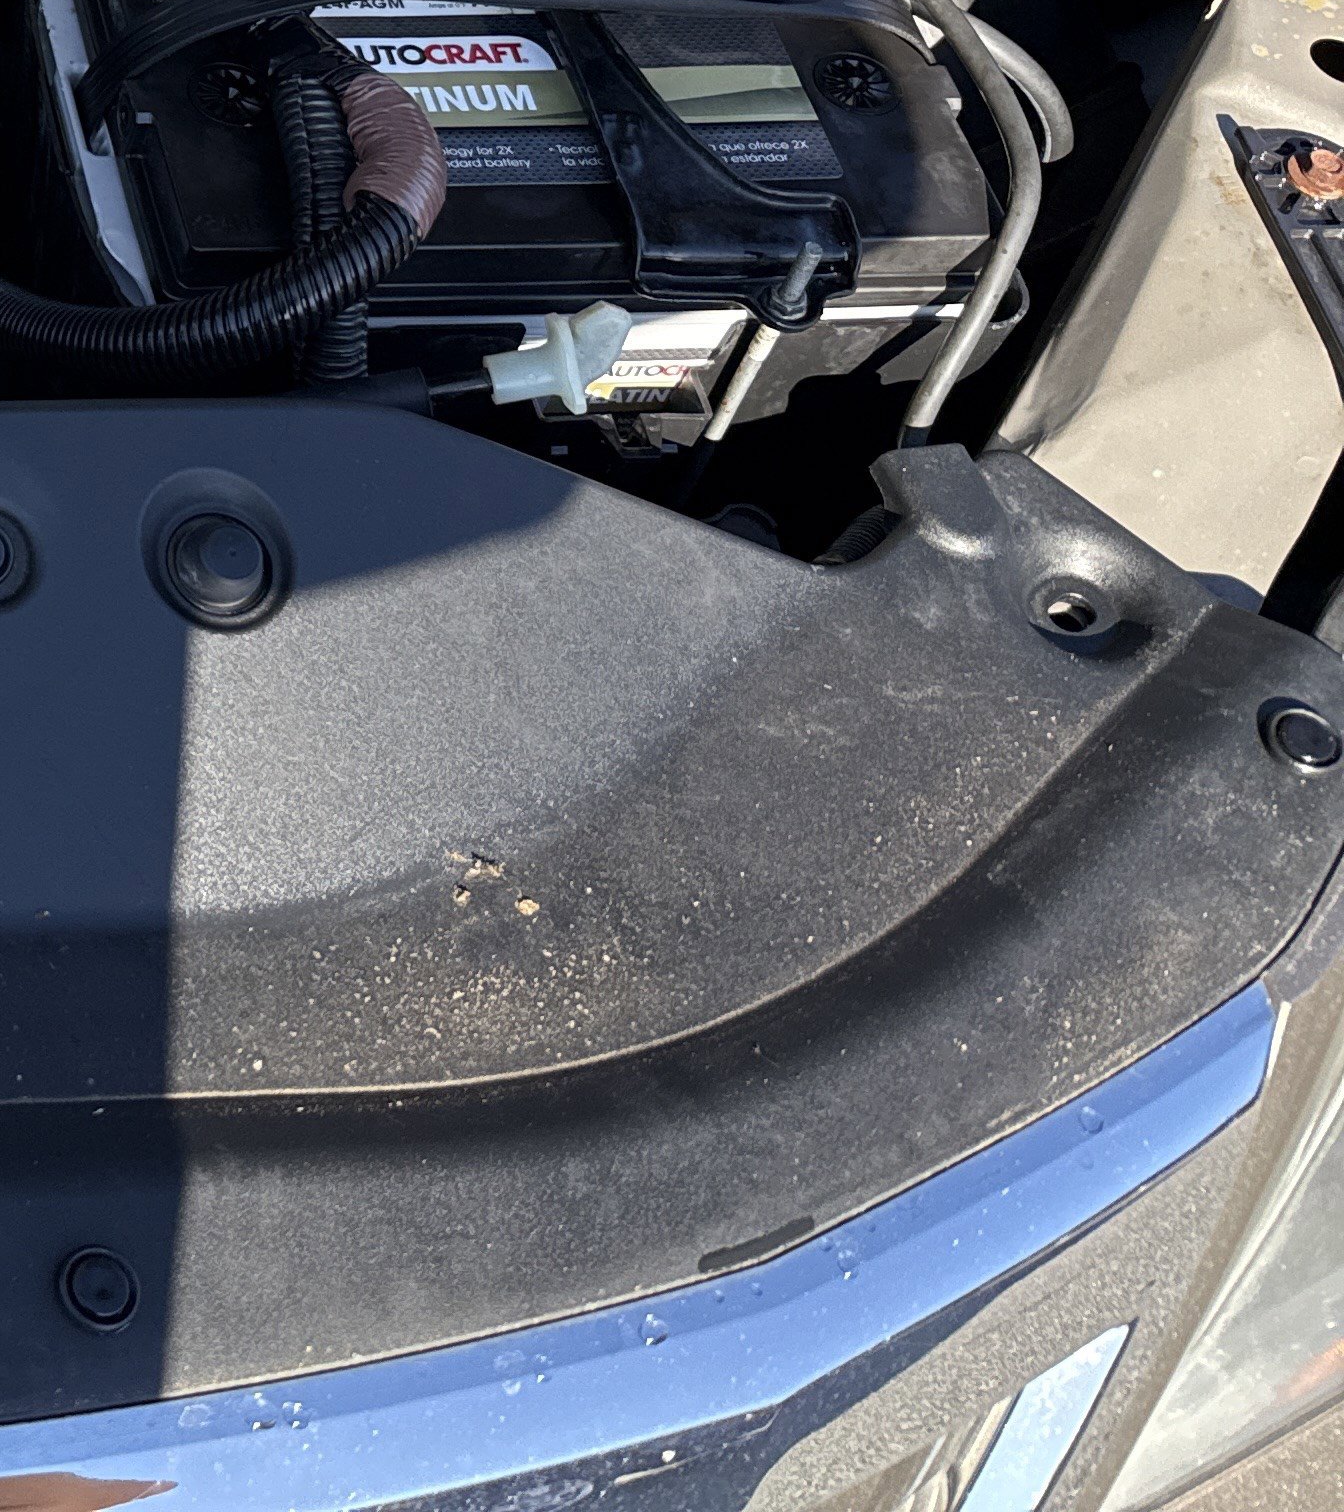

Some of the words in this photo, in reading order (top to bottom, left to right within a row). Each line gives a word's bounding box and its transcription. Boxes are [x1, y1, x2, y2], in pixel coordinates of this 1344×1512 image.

[354, 43, 523, 66] UTOCRAFT
[404, 85, 538, 112] TINUM
[555, 145, 599, 155] Tecnol
[484, 158, 530, 169] battery
